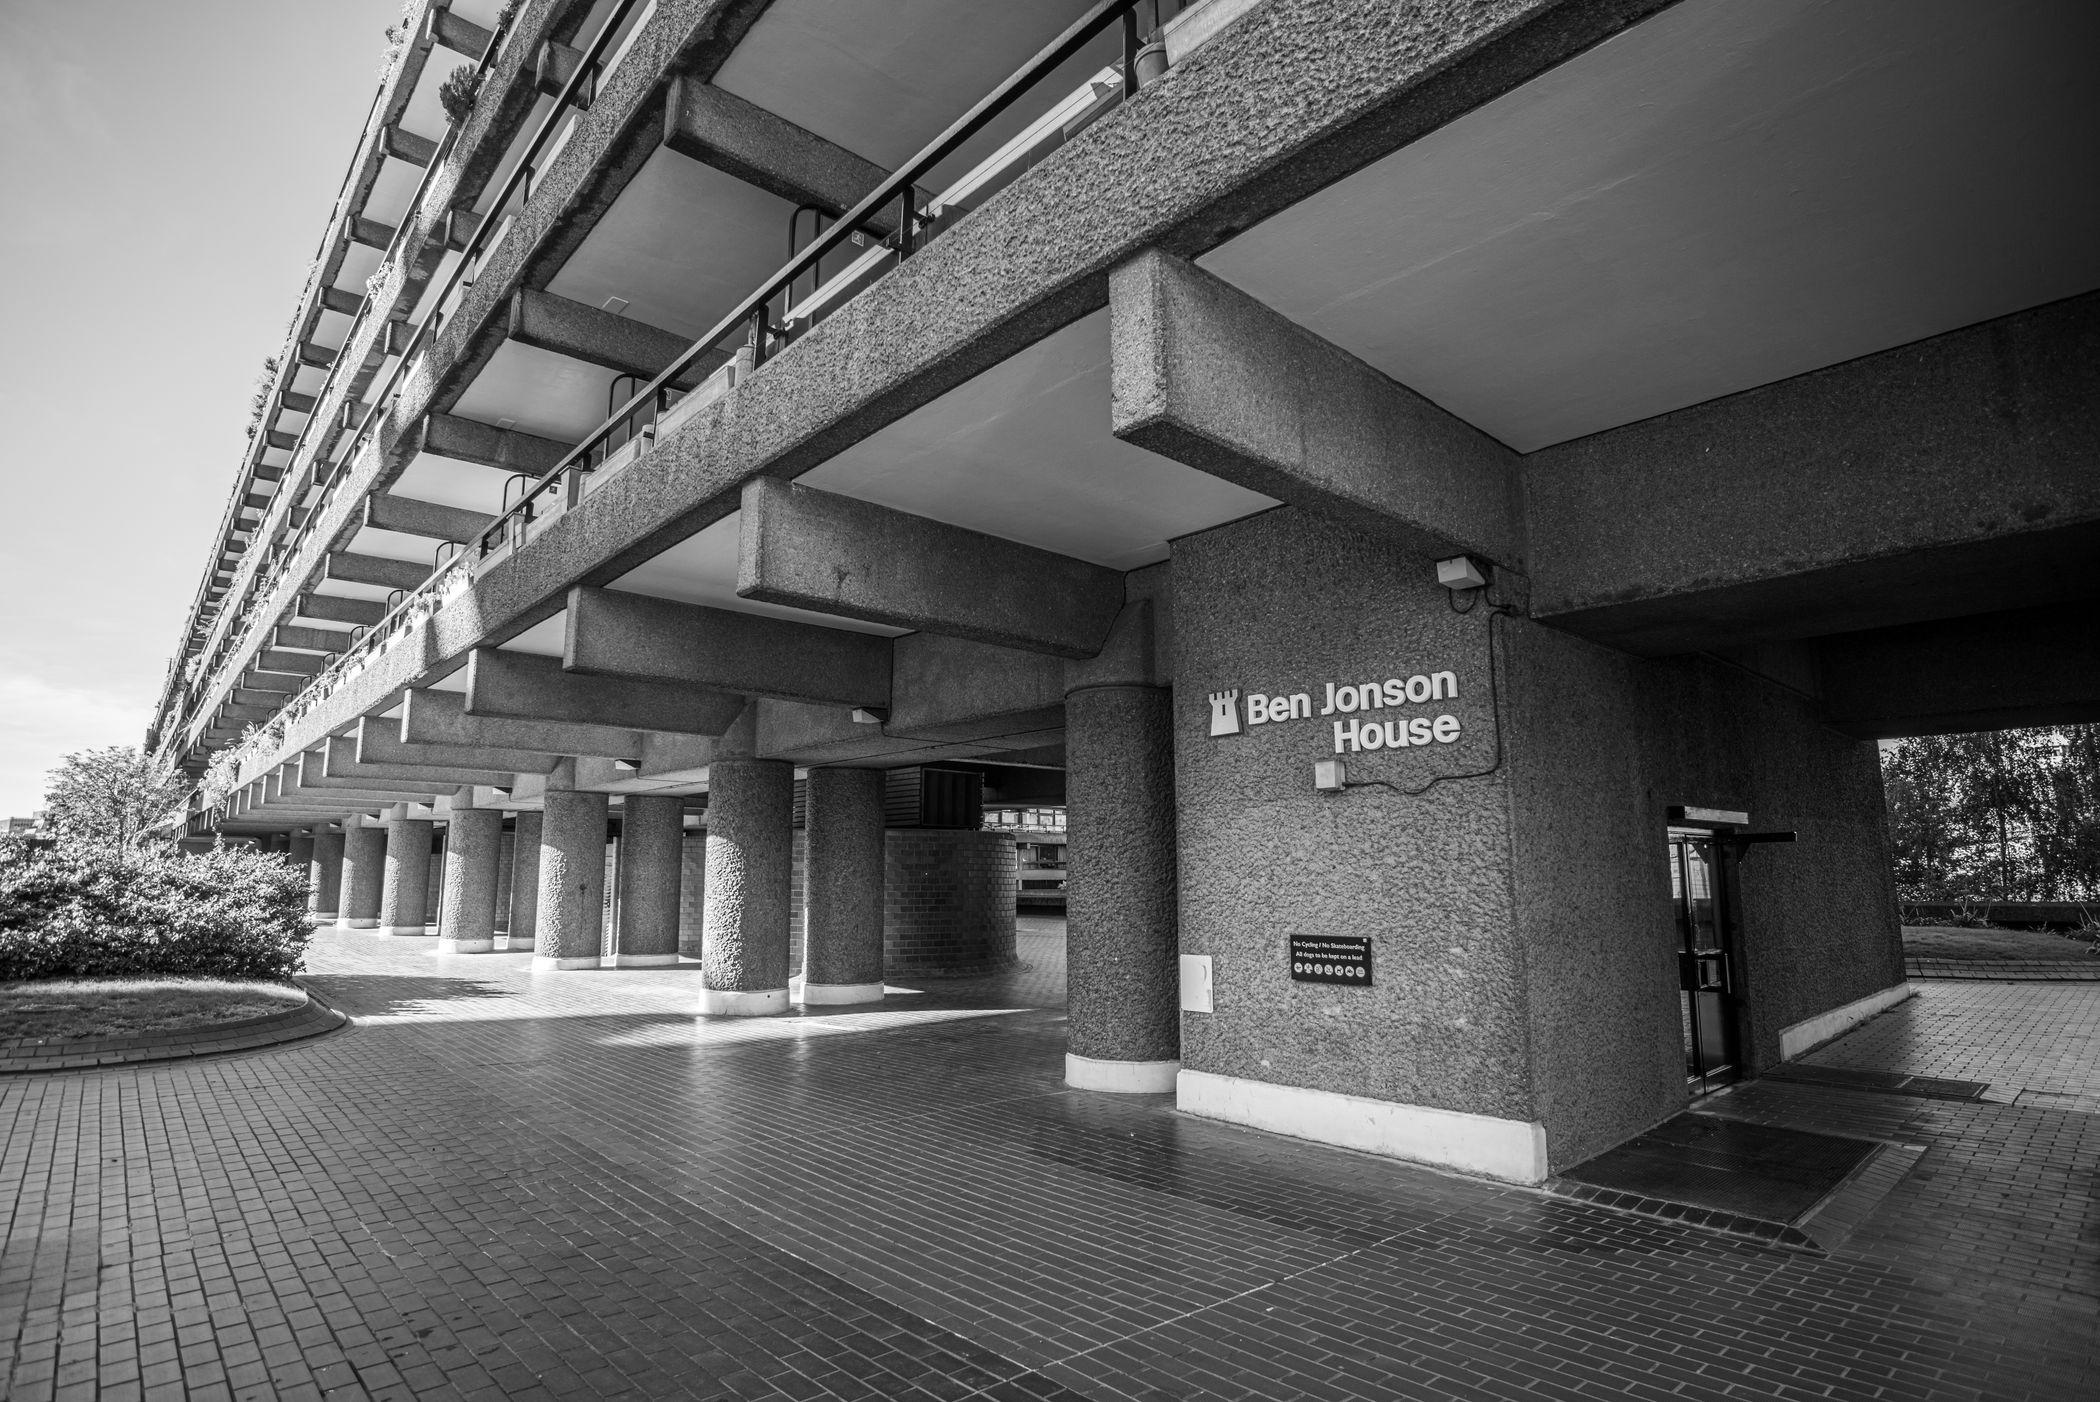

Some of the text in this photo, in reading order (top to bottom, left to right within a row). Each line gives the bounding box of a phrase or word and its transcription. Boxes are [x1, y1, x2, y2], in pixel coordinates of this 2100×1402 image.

[1247, 670, 1459, 725] Ben Jonson
[1333, 714, 1461, 754] House
[1301, 941, 1318, 949] Cycling
[1303, 951, 1314, 959] dogs
